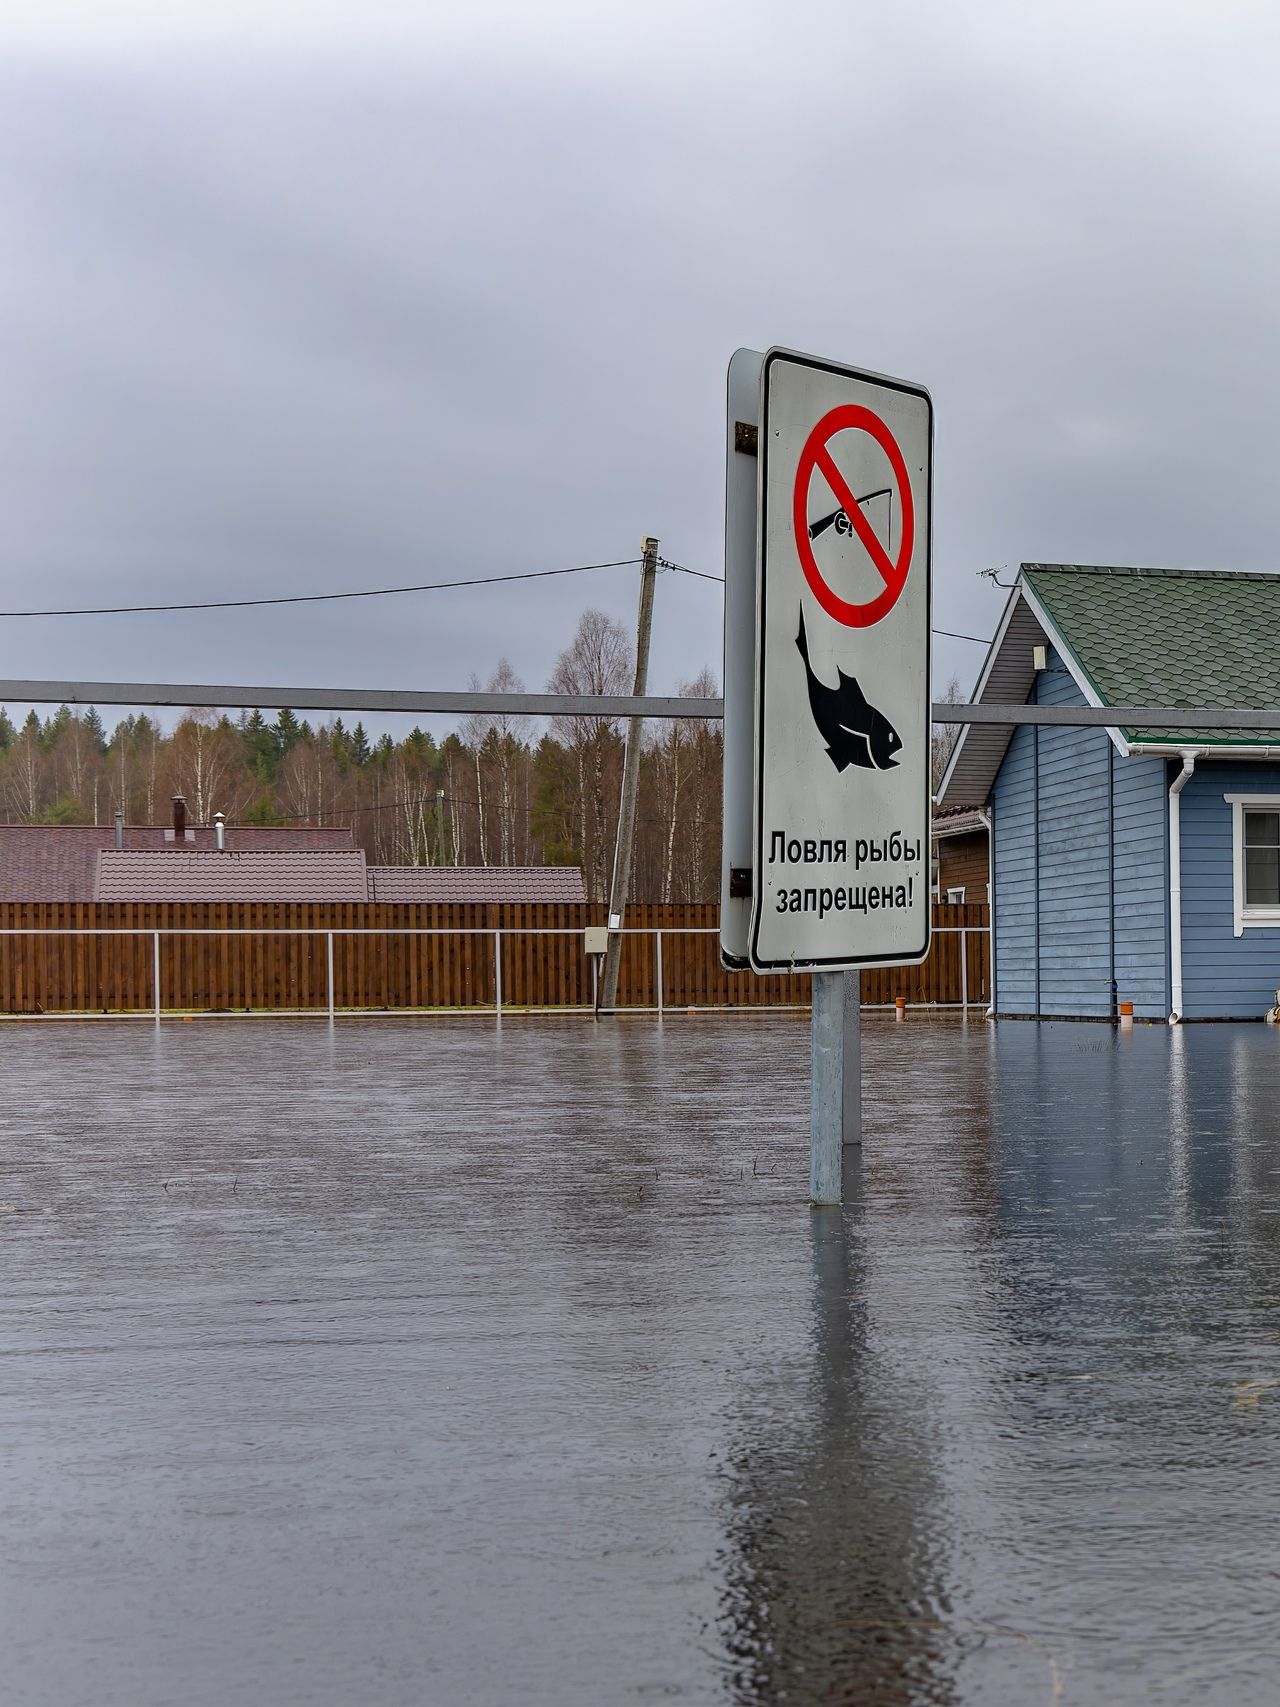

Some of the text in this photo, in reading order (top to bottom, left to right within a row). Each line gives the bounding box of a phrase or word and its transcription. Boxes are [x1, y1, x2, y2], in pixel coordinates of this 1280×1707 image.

[768, 830, 921, 871] Ловля рыбы
[775, 877, 914, 920] запрещена!
